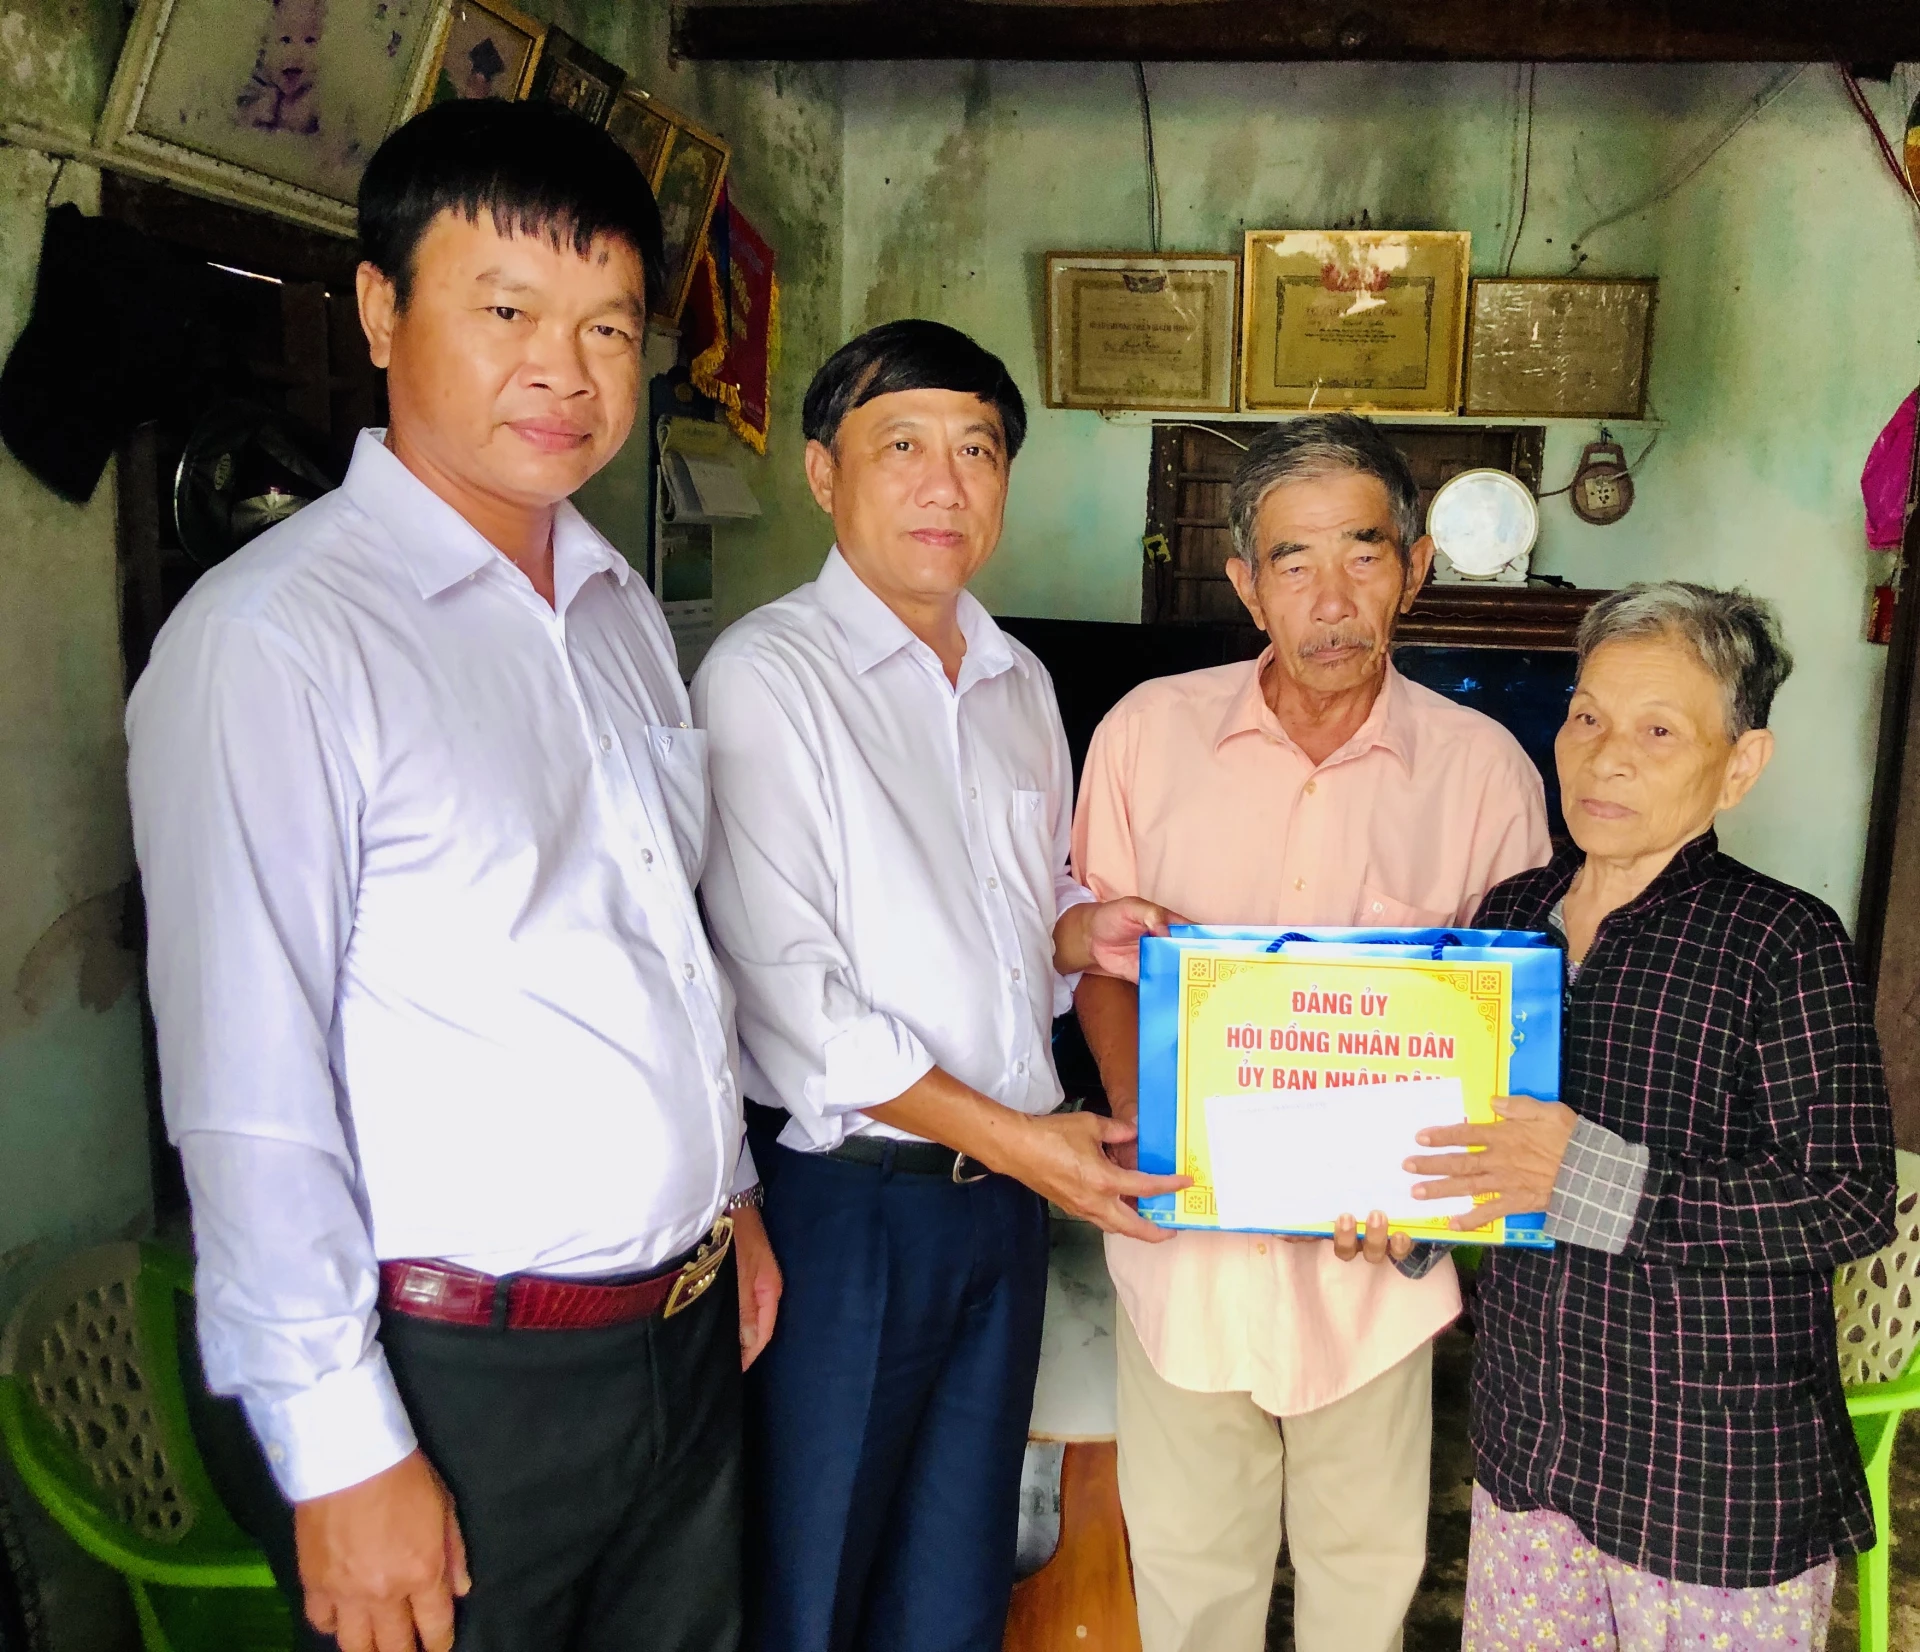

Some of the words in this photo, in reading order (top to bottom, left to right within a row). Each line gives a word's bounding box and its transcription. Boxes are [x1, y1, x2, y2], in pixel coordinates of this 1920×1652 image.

[1291, 984, 1352, 1015] ĐẢNG
[1361, 986, 1388, 1016] ỦY
[1226, 1022, 1262, 1055] HỘI
[1269, 1022, 1330, 1053] ĐỒNG
[1338, 1029, 1400, 1057] NHÂN
[1408, 1031, 1454, 1059] DÂN
[1238, 1059, 1264, 1088] ỦY
[1272, 1068, 1317, 1091] BAN
